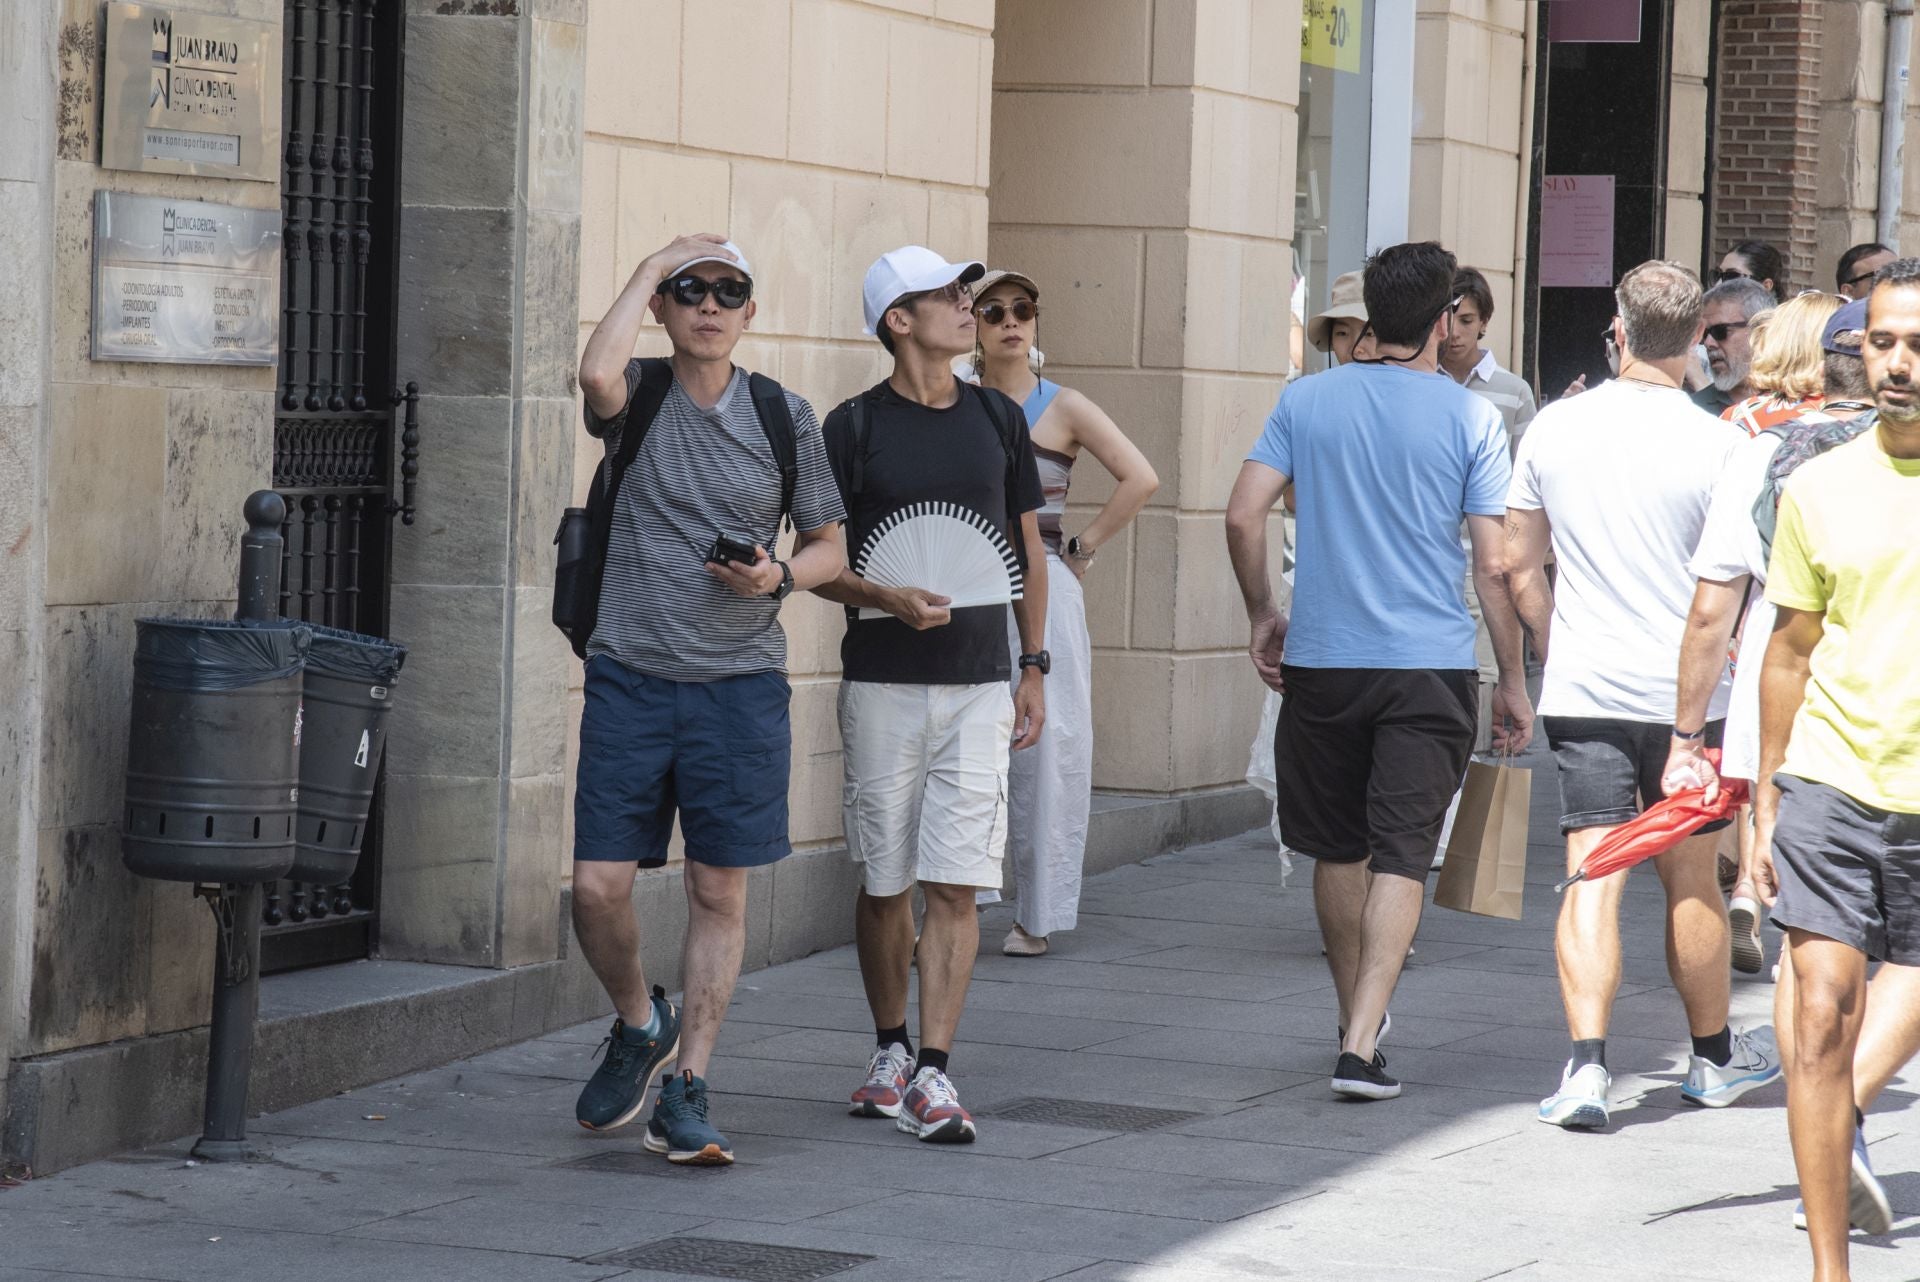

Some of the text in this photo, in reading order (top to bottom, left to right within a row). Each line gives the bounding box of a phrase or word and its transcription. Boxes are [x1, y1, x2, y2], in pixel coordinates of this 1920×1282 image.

[174, 36, 238, 64] JUAN BRAVO
[174, 72, 237, 101] CLÍNICA DENTAL
[146, 134, 233, 152] www.sonriaporfavor.com
[197, 217, 217, 233] DENTAL
[177, 239, 215, 255] JUAN BRAVO
